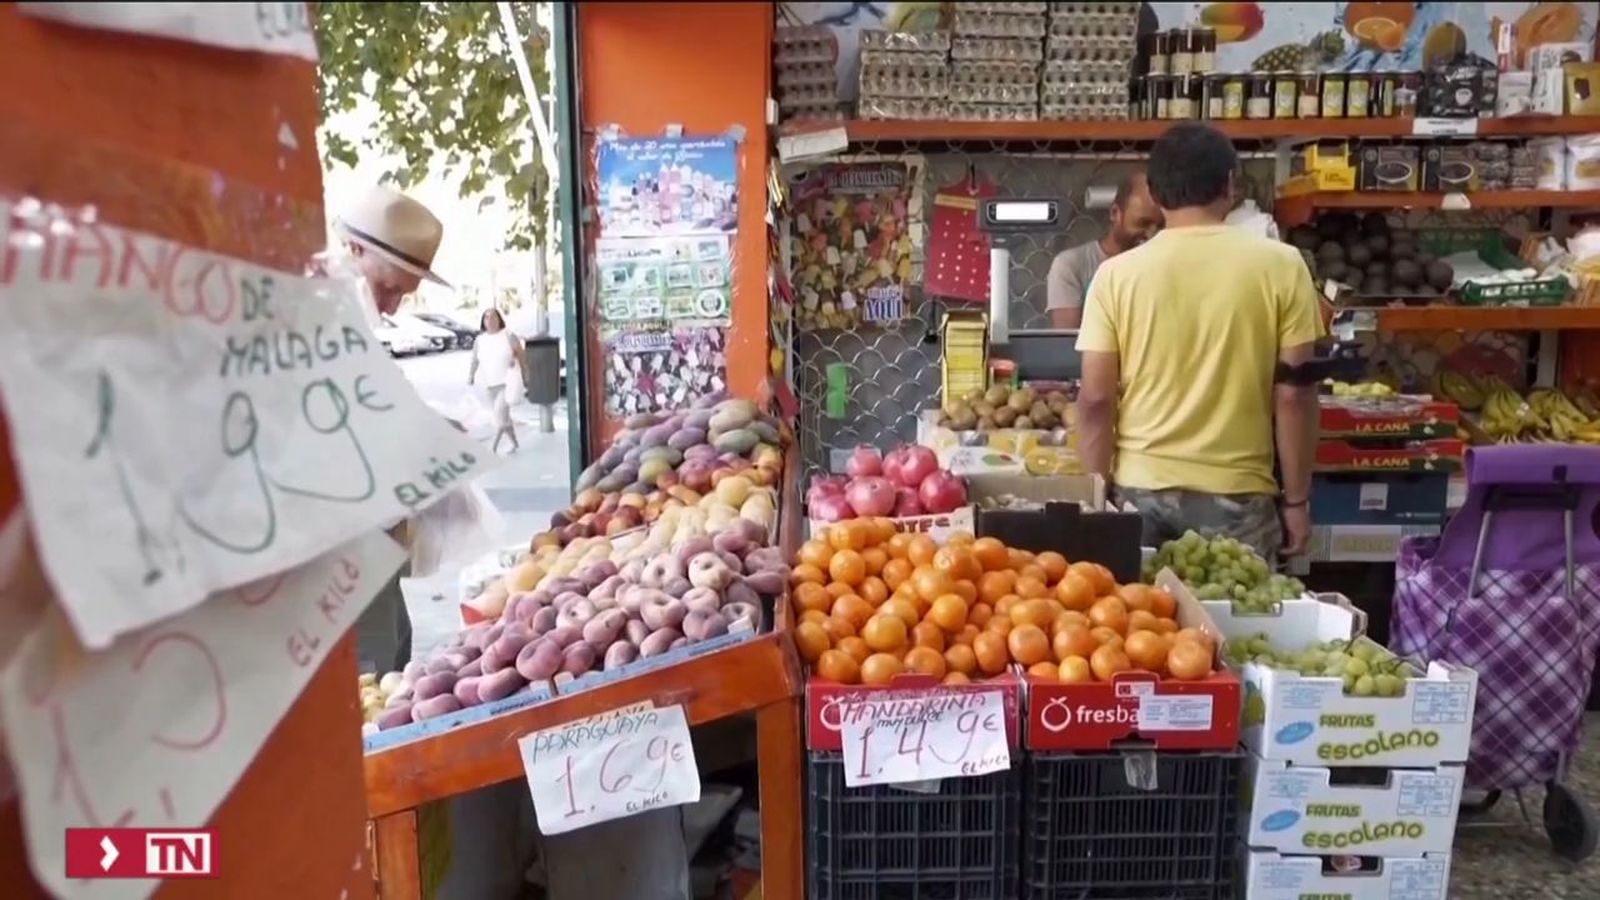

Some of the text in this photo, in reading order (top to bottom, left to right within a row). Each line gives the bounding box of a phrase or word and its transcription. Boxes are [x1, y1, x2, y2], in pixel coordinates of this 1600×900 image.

[0, 203, 276, 325] MANGO DE
[218, 325, 368, 379] MALAGA
[1356, 424, 1372, 432] LA
[423, 452, 476, 489] KILO
[1353, 458, 1369, 467] LA
[286, 558, 360, 667] EL KILO
[1318, 714, 1376, 728] FRUTAS
[533, 712, 659, 764] PARAGUAYA
[626, 801, 638, 812] EL
[1304, 804, 1362, 817] FRUTAS
